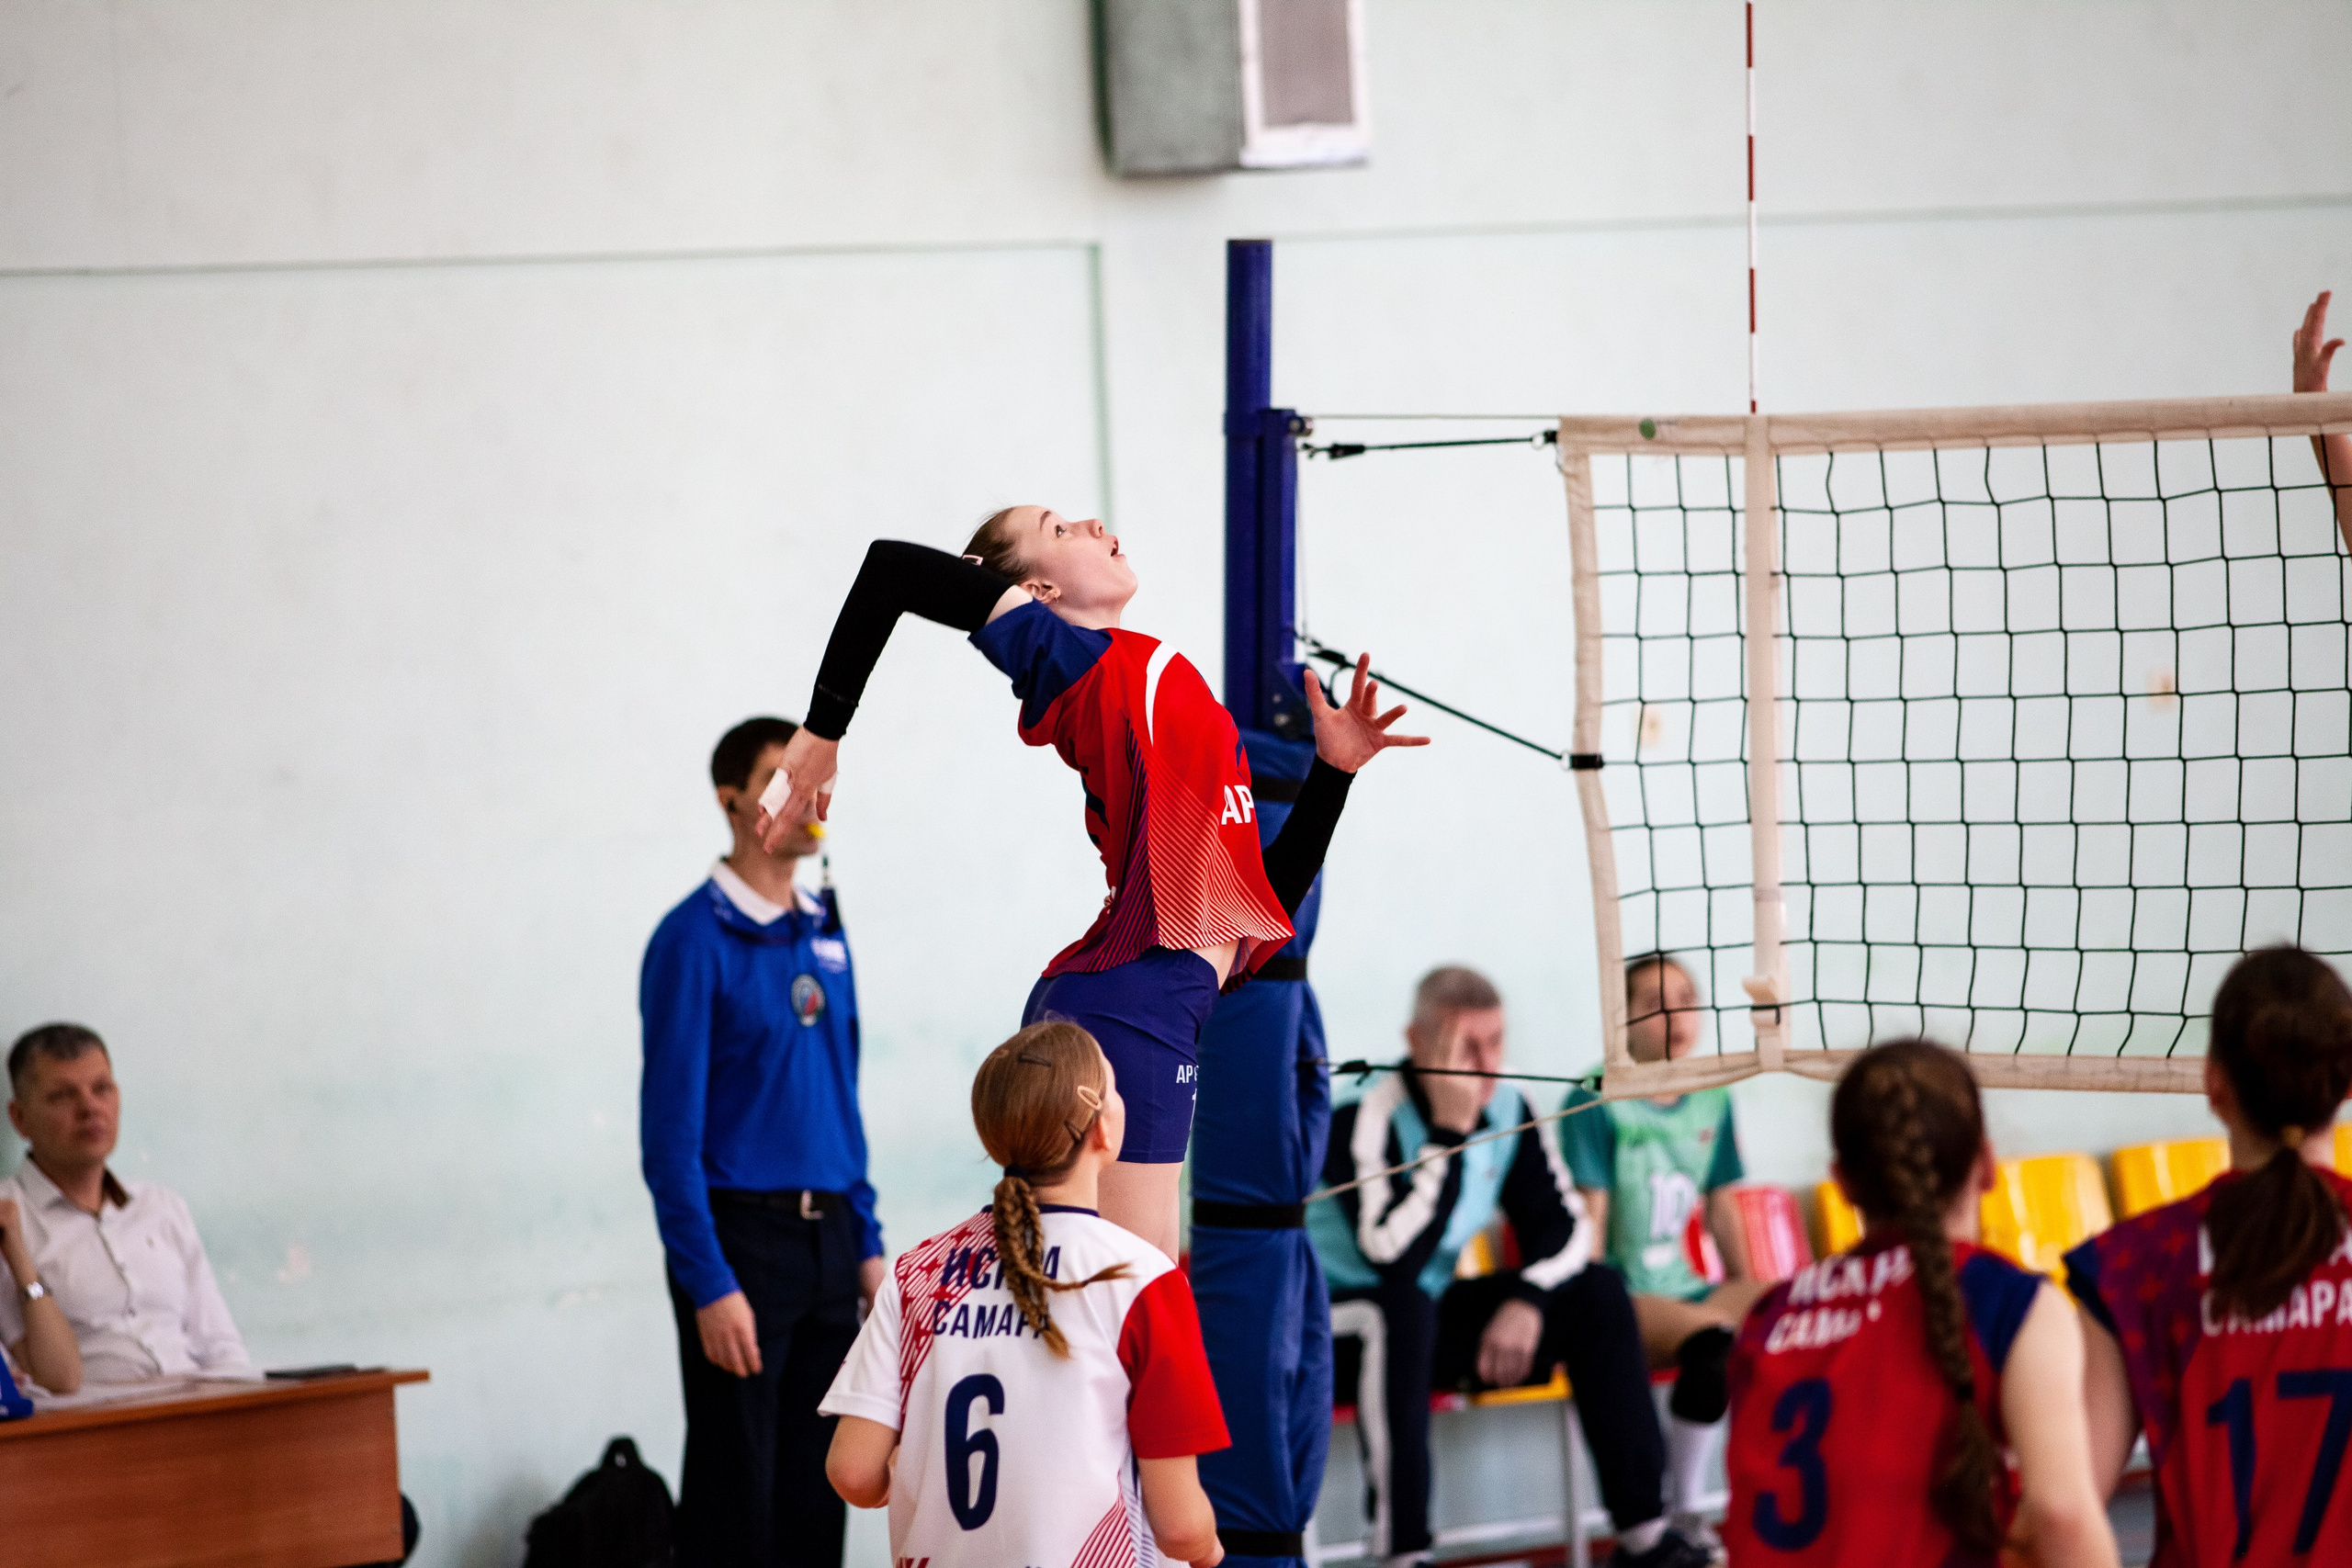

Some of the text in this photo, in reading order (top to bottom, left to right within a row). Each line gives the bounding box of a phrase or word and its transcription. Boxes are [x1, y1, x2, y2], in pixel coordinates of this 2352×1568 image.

[940, 1246, 1061, 1291] ИСА
[2199, 1278, 2352, 1337] САРА
[944, 1373, 1005, 1531] 6
[1752, 1377, 1834, 1551] 3
[2206, 1369, 2352, 1560] 17
